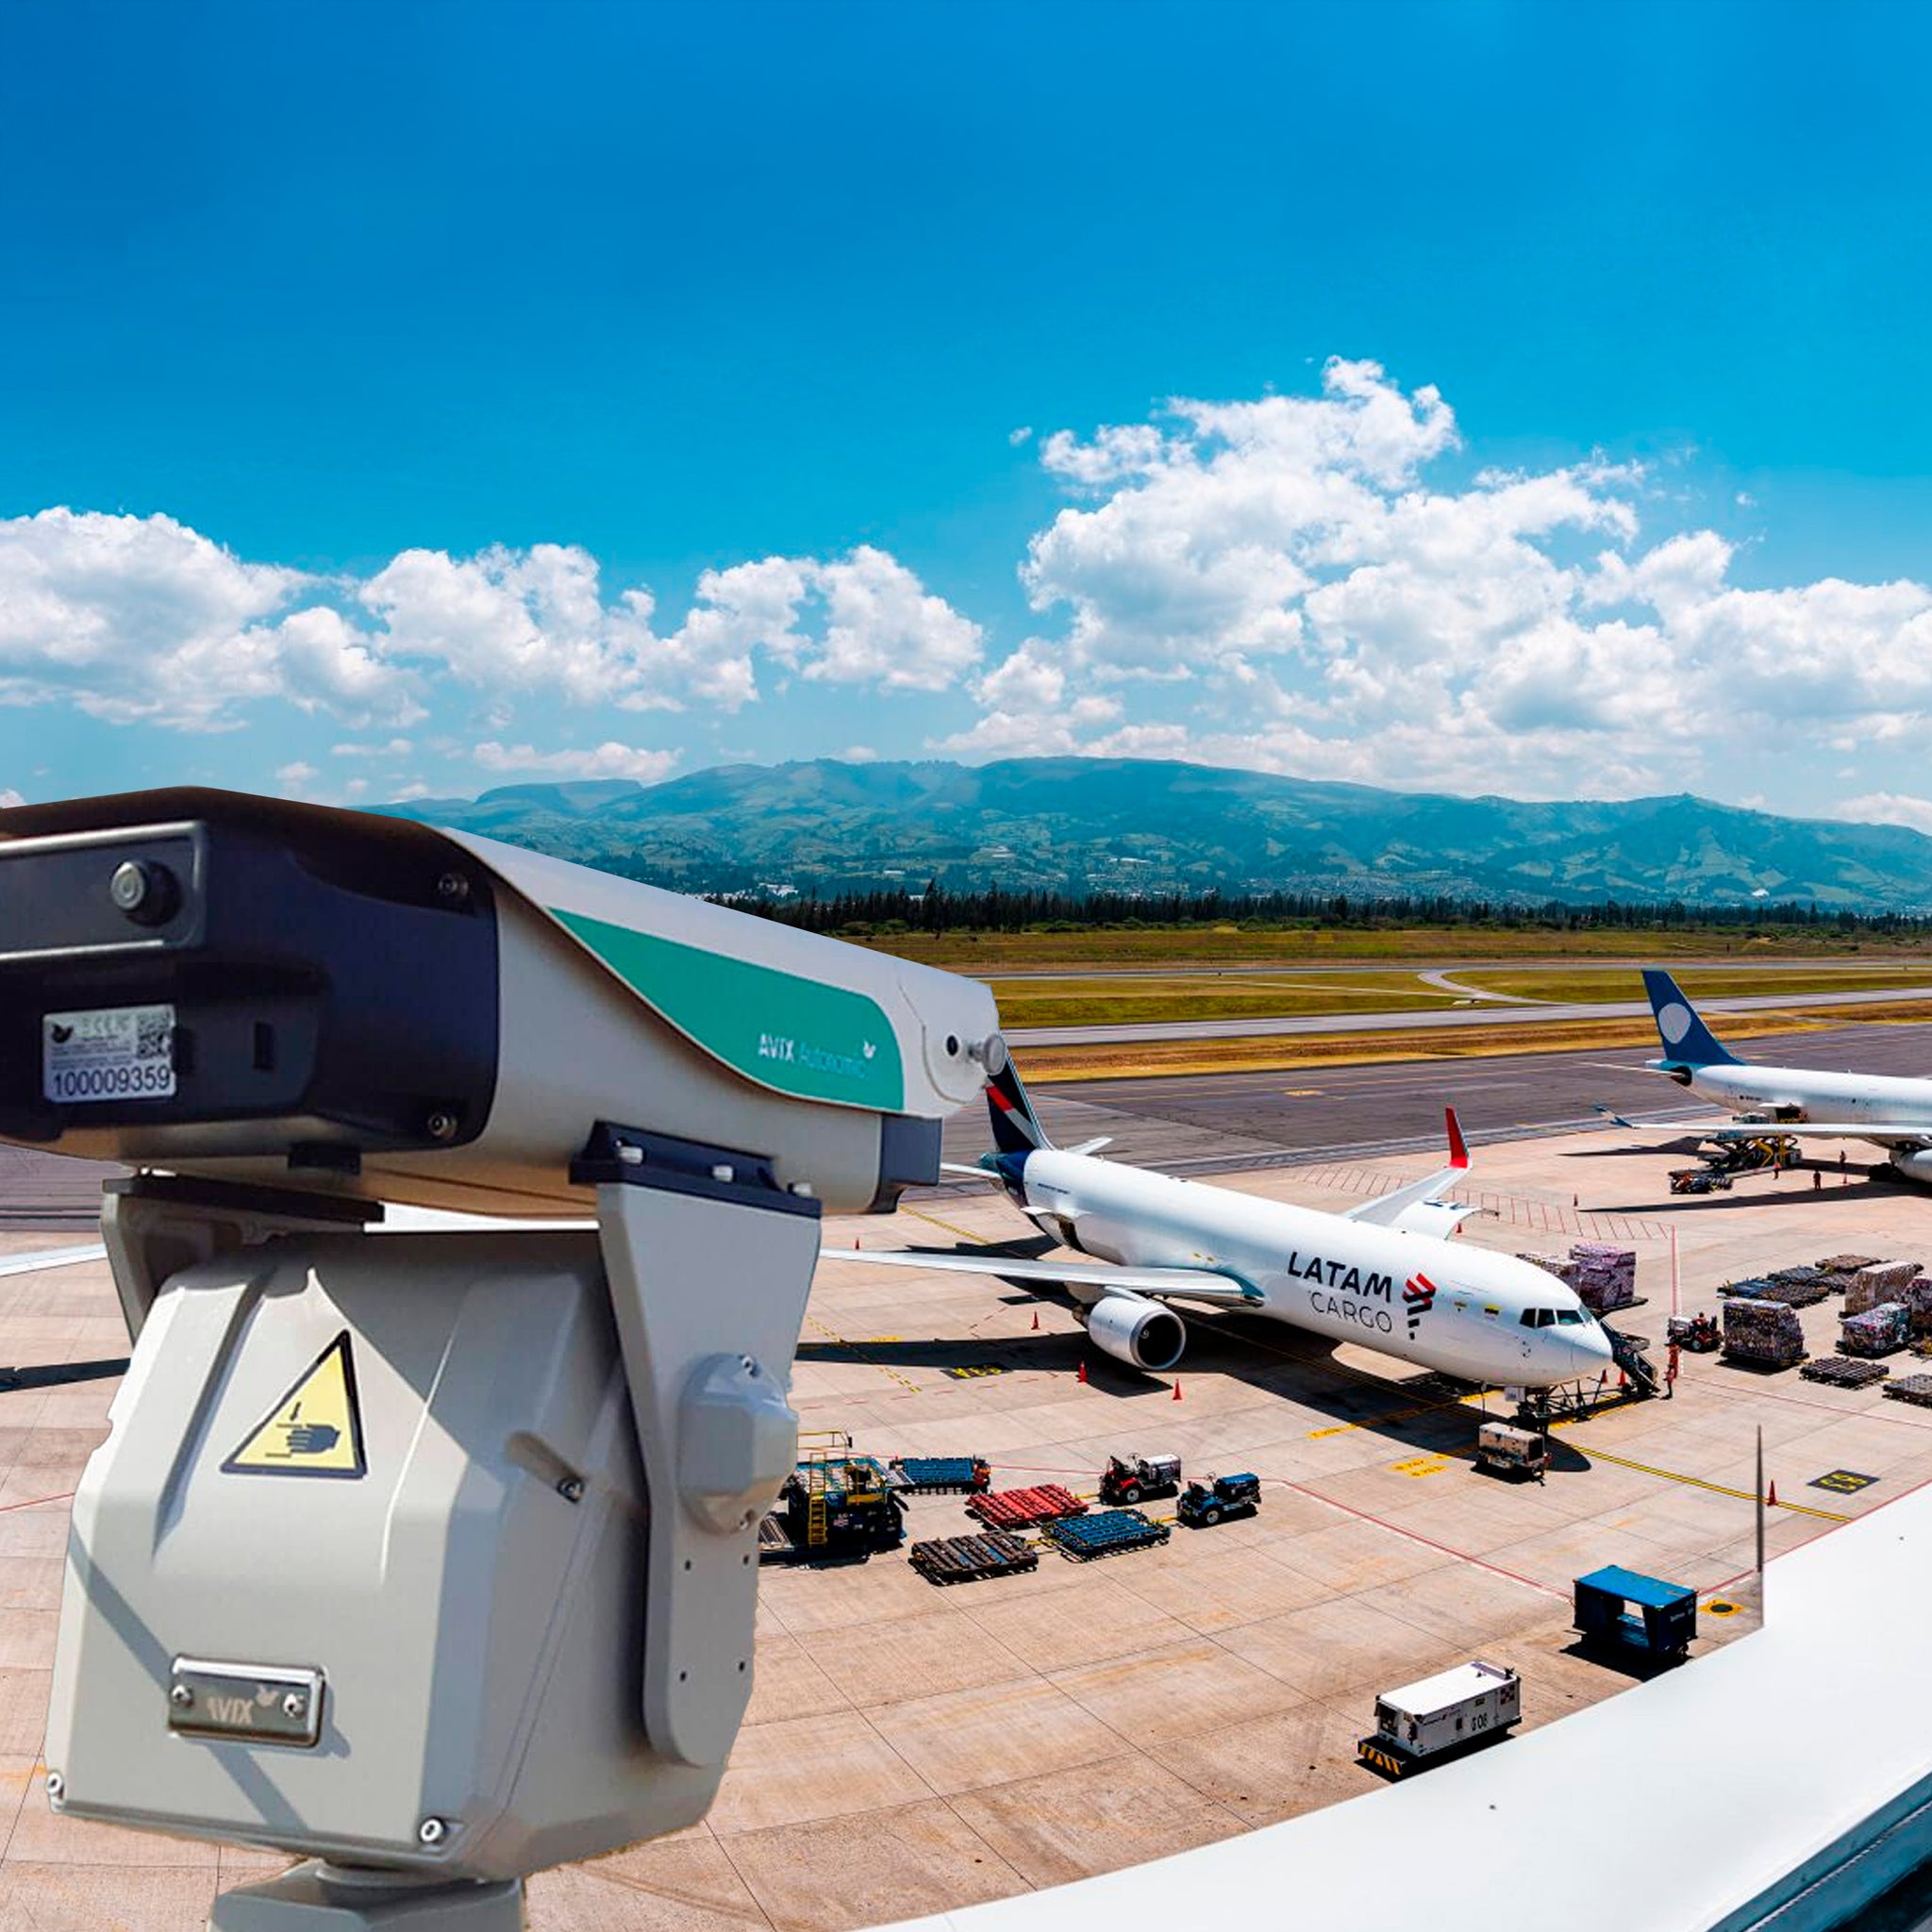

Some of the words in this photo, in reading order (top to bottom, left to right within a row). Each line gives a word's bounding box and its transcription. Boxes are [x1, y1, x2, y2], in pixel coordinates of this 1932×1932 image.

[758, 1033, 795, 1063] AVIX
[54, 1064, 171, 1097] 100009359
[1288, 1251, 1392, 1303] LATAM
[1309, 1291, 1392, 1334] CARGO
